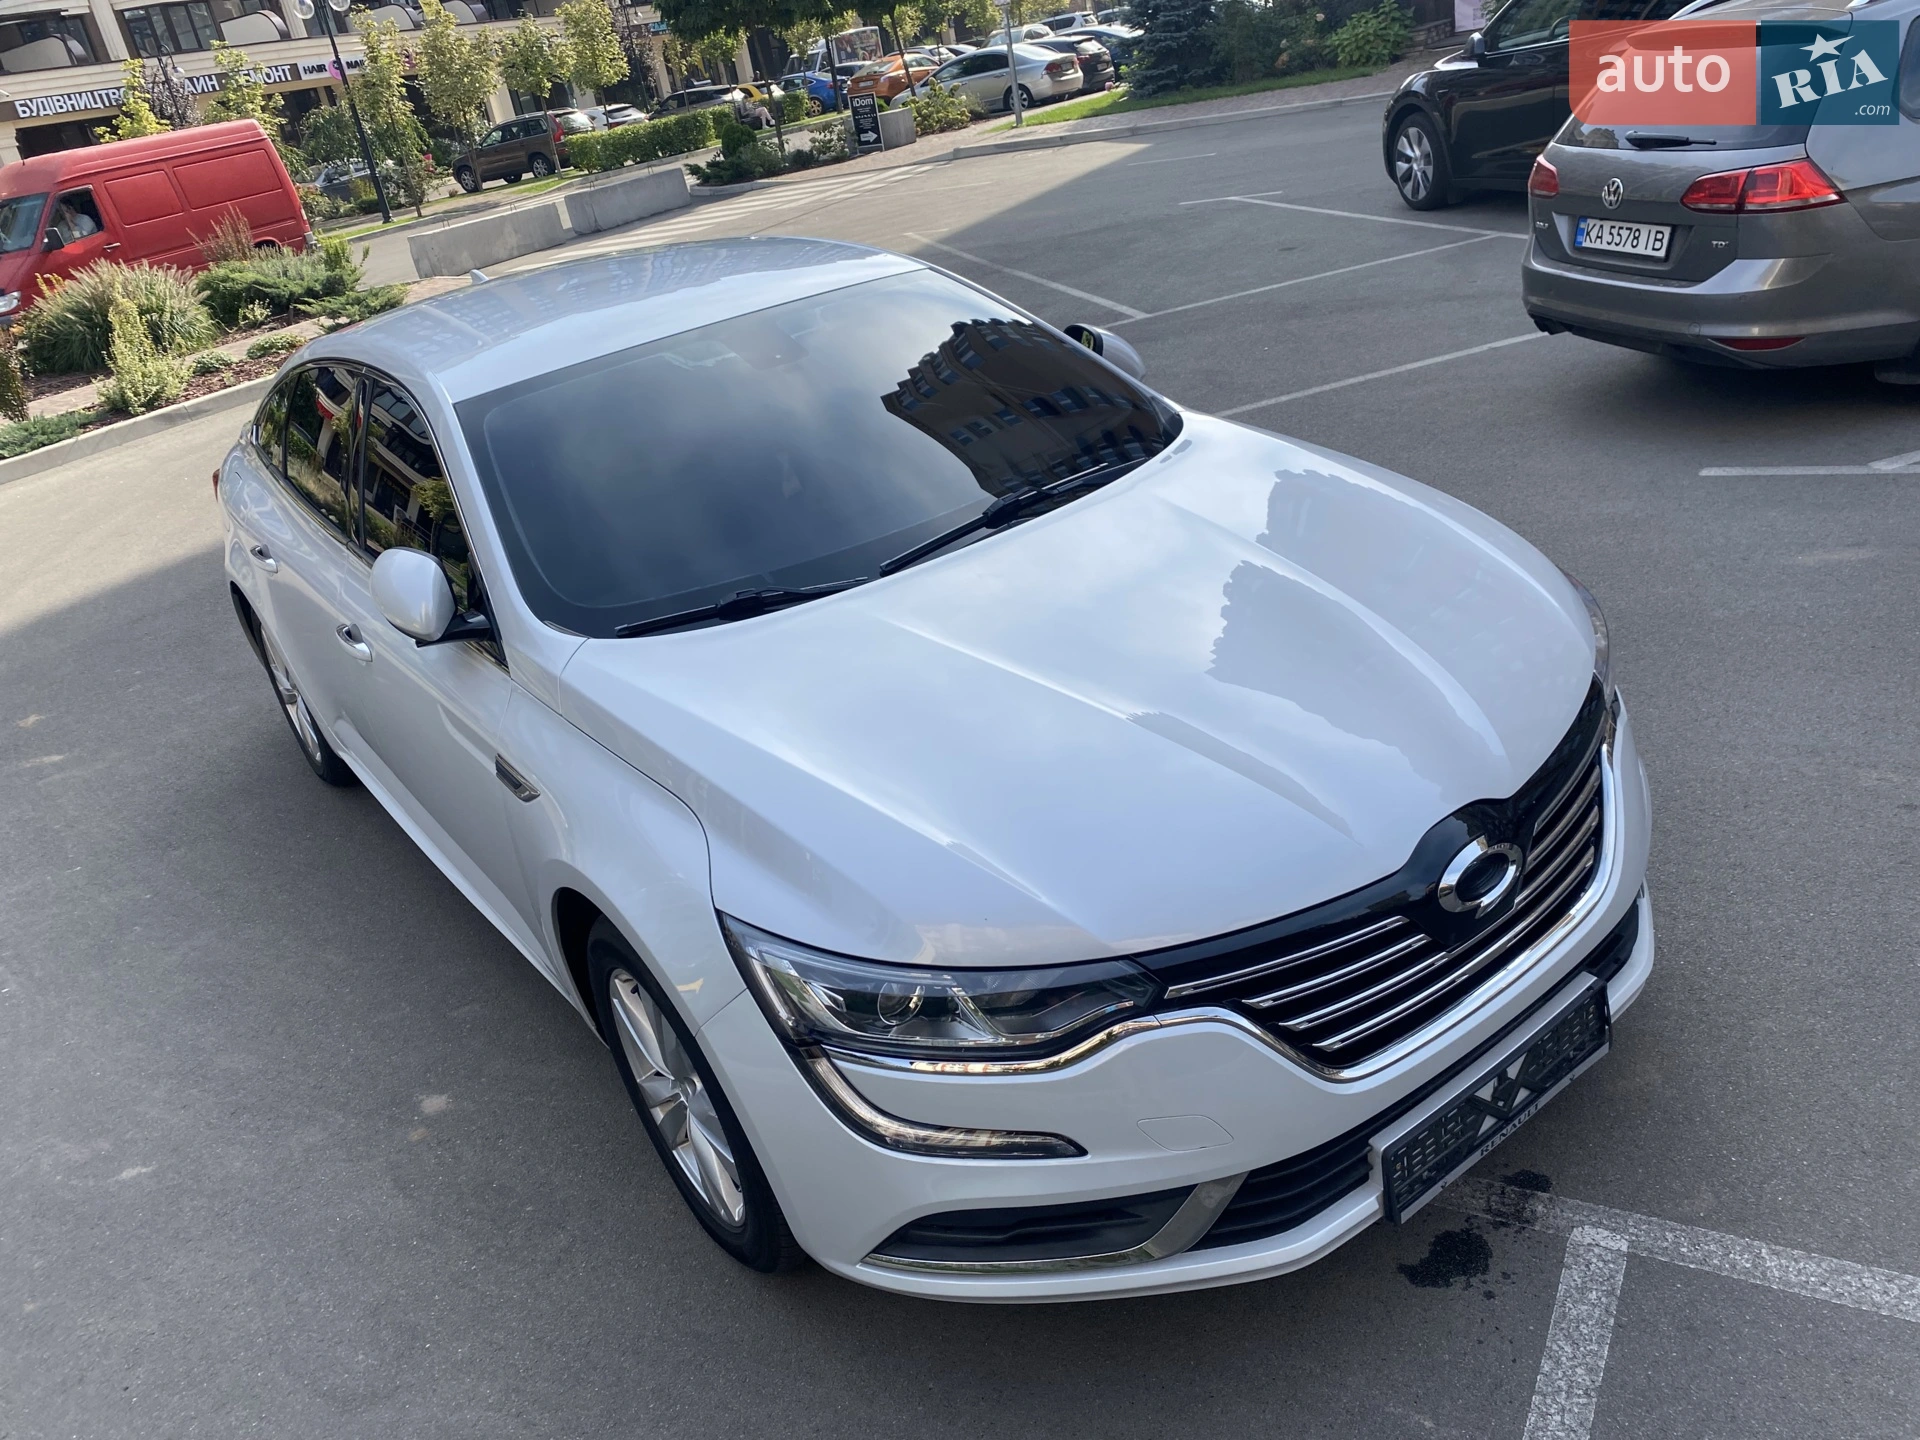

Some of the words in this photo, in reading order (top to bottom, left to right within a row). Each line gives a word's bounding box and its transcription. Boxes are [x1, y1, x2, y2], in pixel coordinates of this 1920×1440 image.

[232, 65, 293, 88] ЕМОНТ
[303, 63, 328, 75] HAIR
[852, 97, 873, 107] iDom
[1584, 223, 1604, 244] KA
[1606, 226, 1641, 249] 5578
[1644, 229, 1665, 252] IB
[1480, 1103, 1539, 1157] RENAULT
